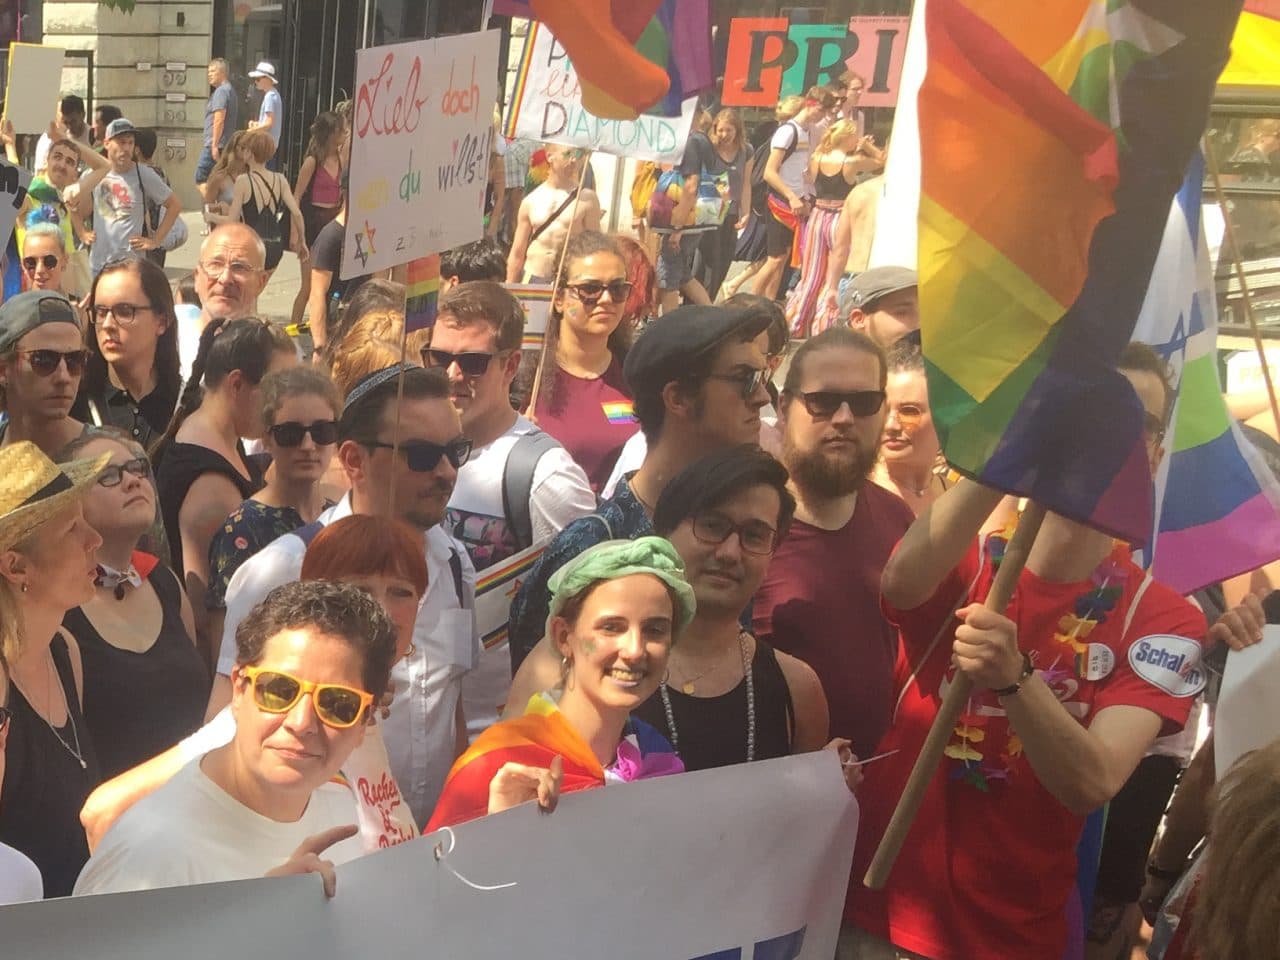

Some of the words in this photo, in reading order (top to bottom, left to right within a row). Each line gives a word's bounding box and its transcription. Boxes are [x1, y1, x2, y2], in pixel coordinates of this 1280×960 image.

[355, 52, 428, 139] Lieb
[441, 55, 480, 121] doch
[541, 101, 677, 153] DIAMOND
[399, 148, 421, 202] du
